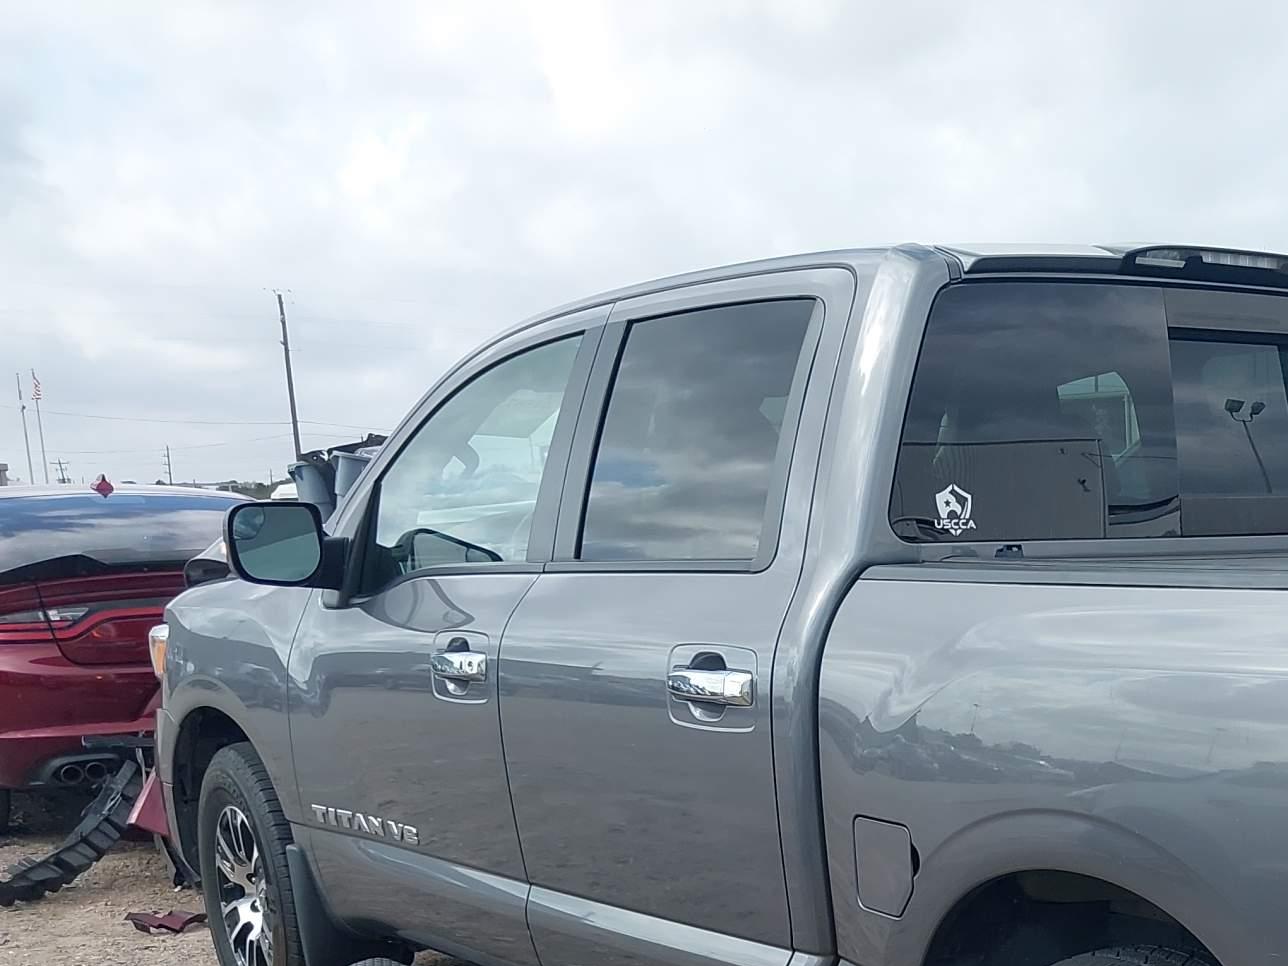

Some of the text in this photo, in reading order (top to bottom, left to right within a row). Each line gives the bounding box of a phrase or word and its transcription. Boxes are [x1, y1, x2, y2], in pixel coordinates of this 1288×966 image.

[934, 519, 977, 529] USCCA
[311, 803, 419, 845] TITAN V8
